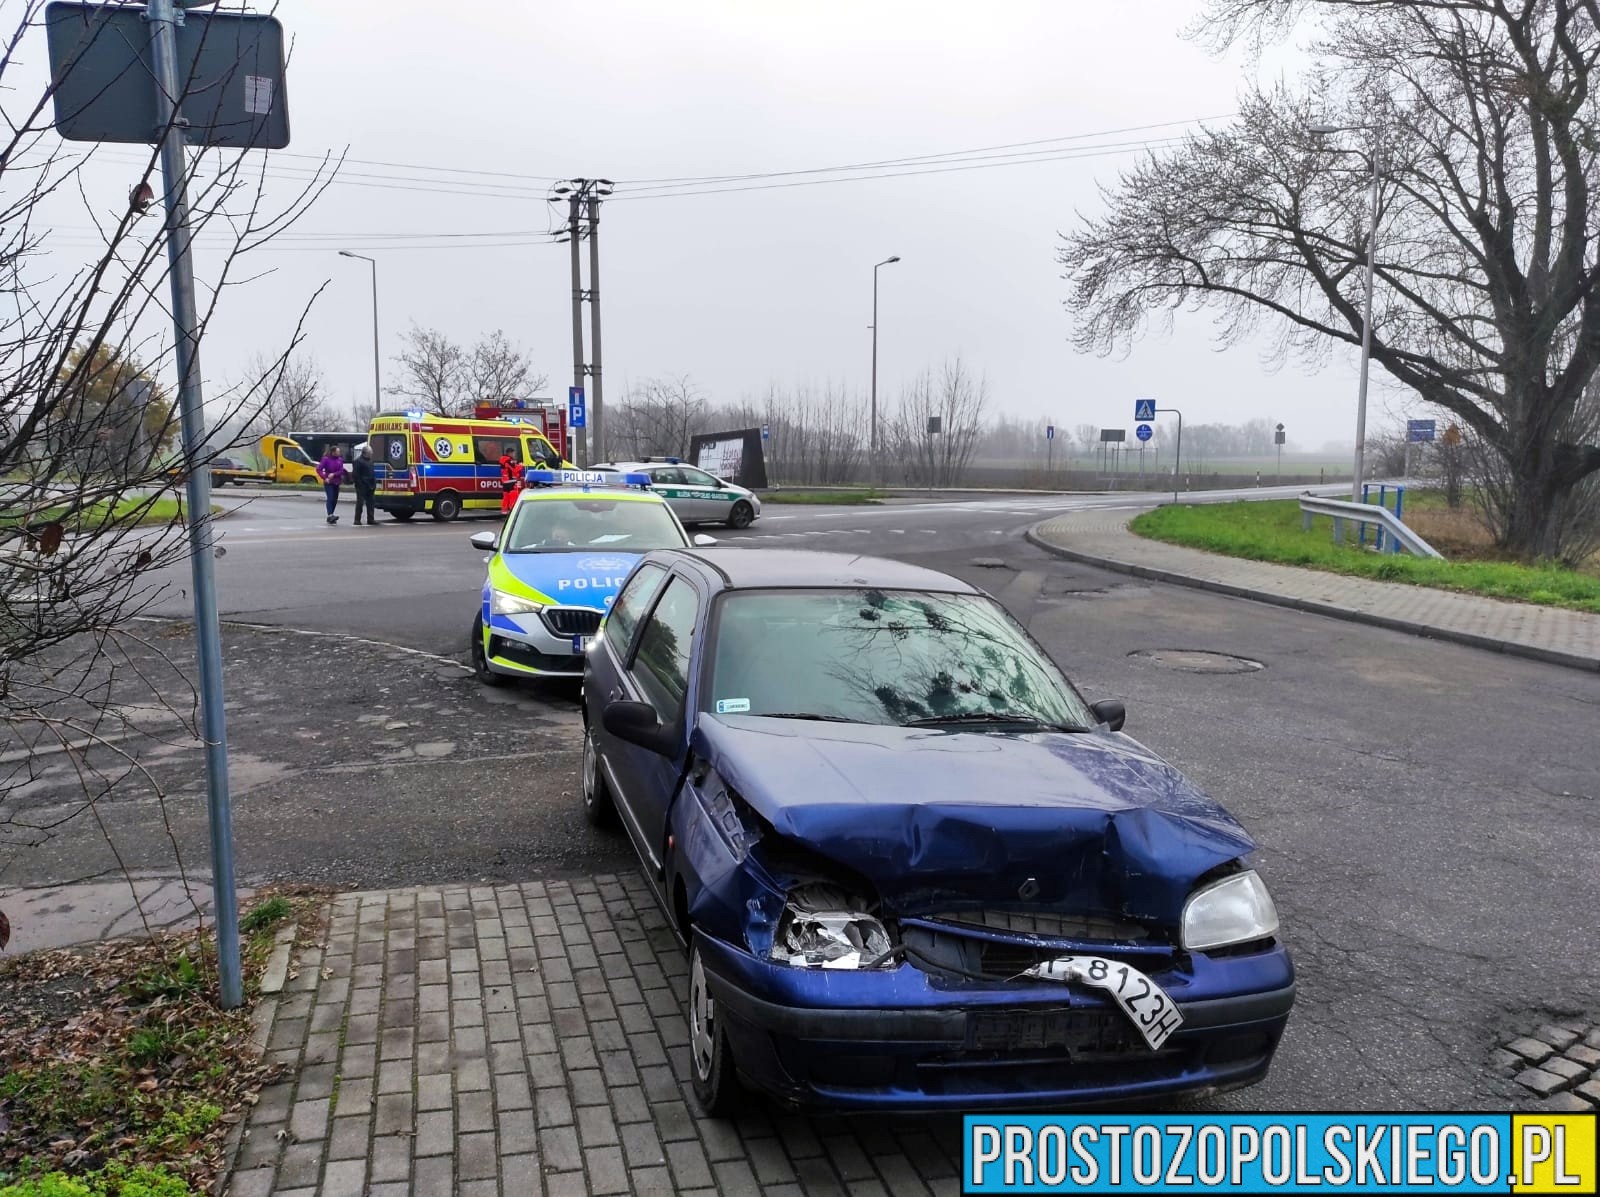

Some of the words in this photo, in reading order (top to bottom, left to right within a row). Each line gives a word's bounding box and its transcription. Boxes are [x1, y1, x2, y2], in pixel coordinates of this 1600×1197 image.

[573, 406, 582, 421] P
[564, 472, 603, 482] POLICJA
[558, 576, 626, 591] POLIC
